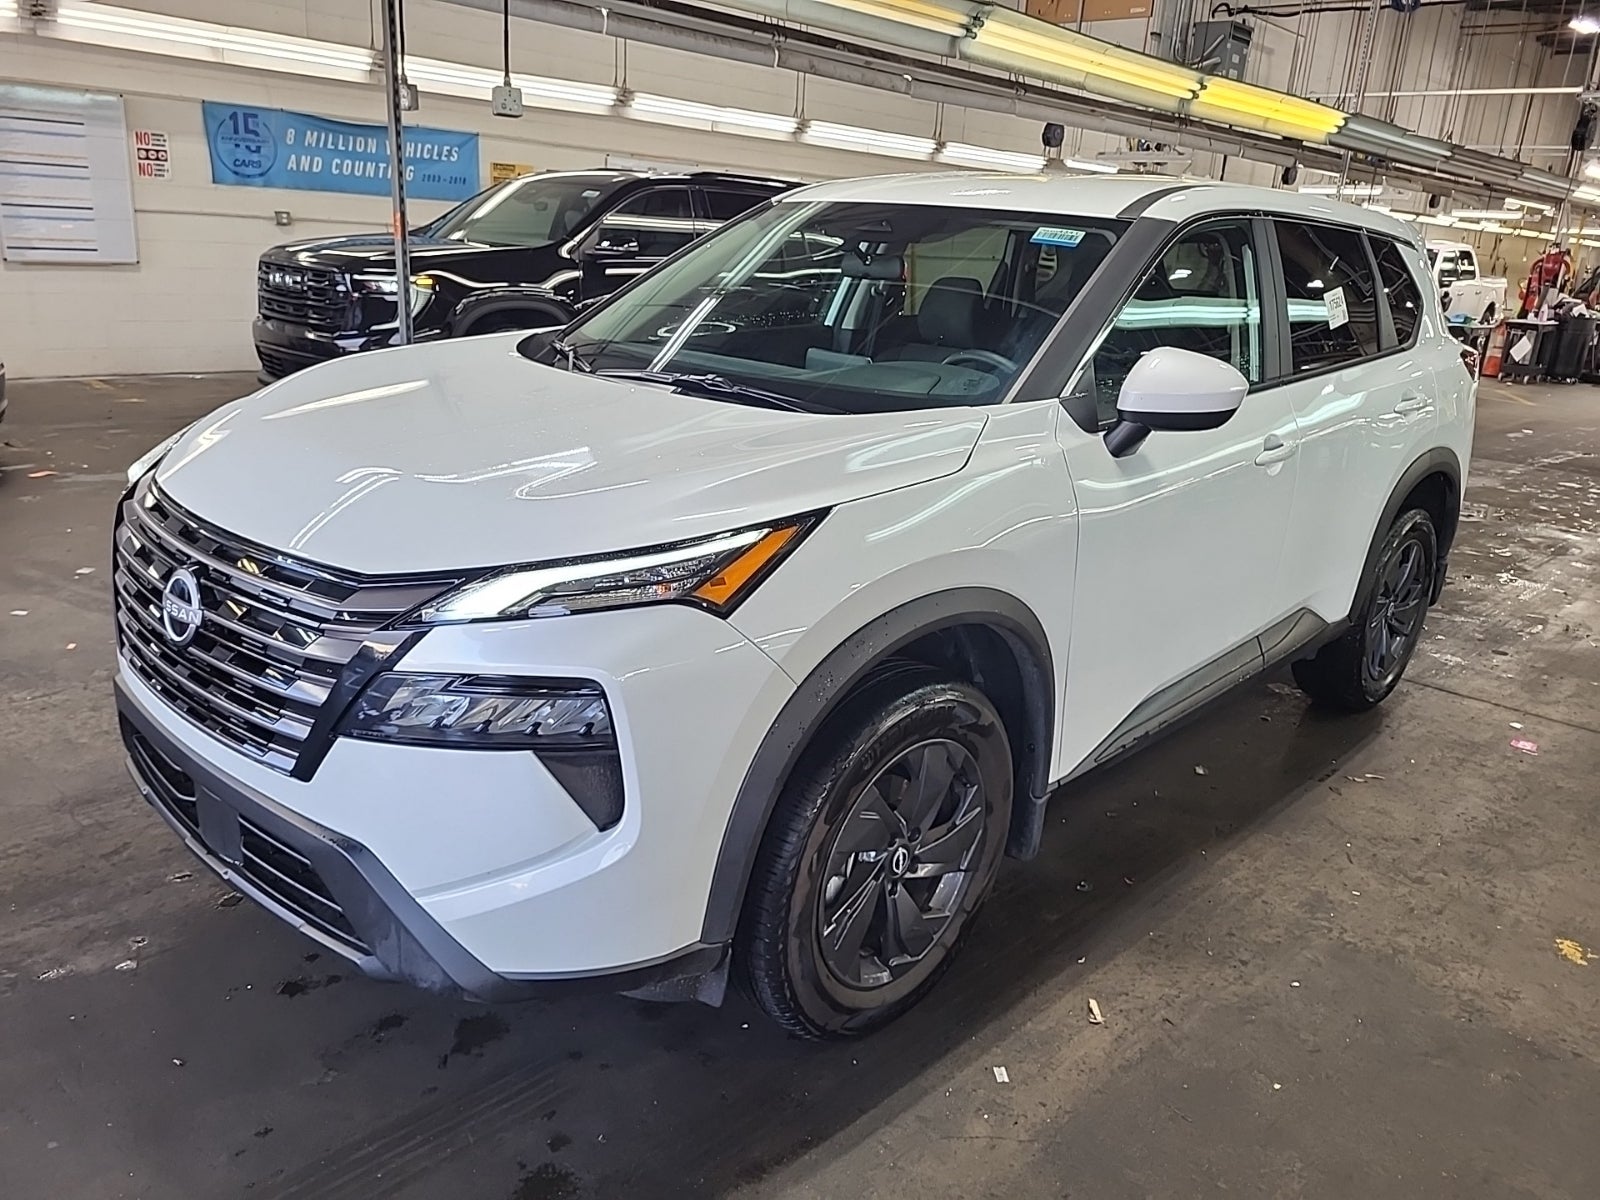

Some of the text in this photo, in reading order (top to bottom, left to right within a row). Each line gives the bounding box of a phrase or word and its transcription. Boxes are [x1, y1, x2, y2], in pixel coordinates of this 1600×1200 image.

[135, 131, 150, 146] NO
[229, 111, 261, 154] 15
[286, 128, 459, 162] 8 MILLION VHICLES
[138, 162, 153, 177] NO
[233, 159, 262, 169] CARS
[287, 154, 415, 182] AND COUNTIG
